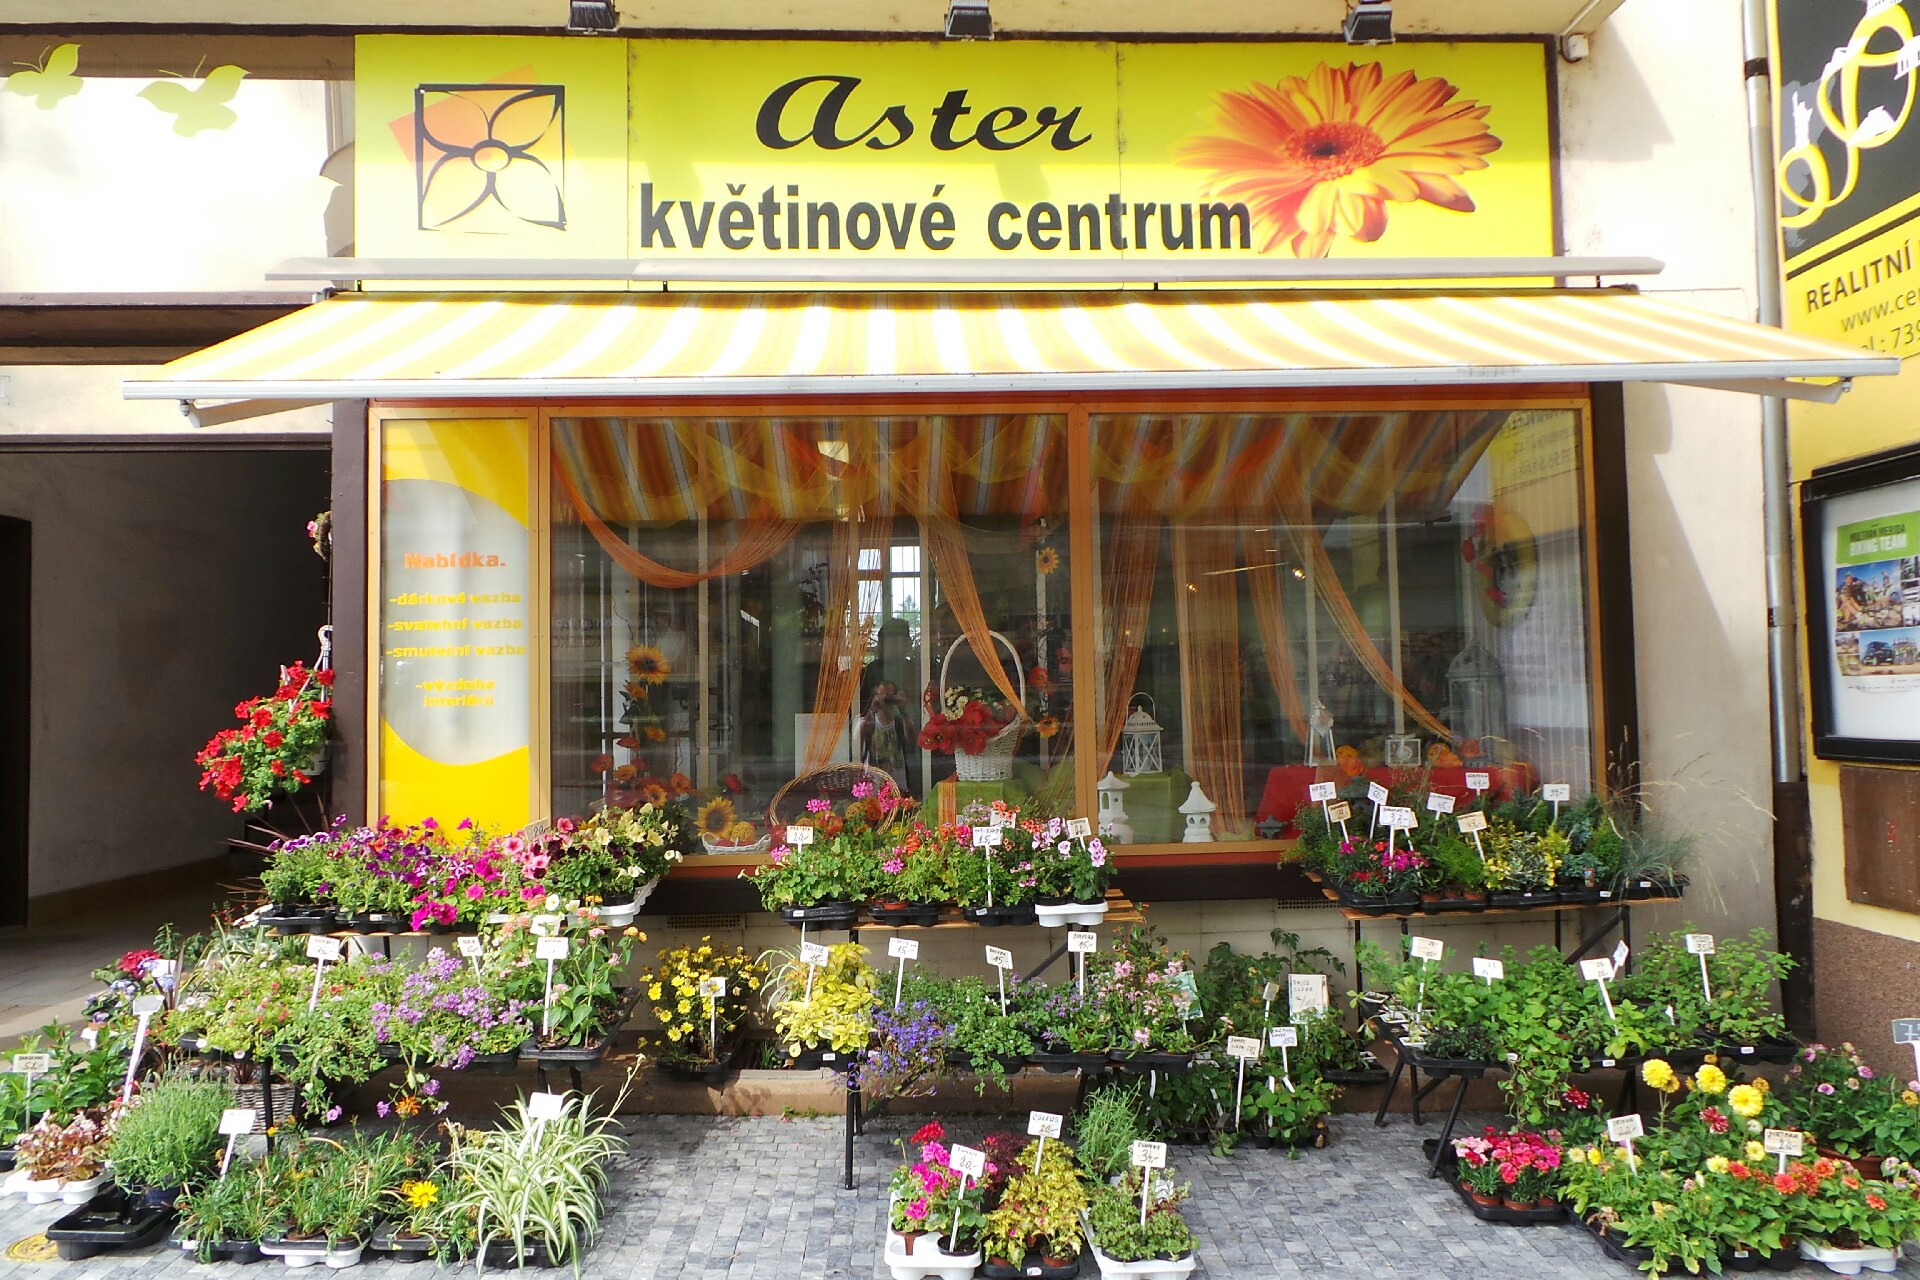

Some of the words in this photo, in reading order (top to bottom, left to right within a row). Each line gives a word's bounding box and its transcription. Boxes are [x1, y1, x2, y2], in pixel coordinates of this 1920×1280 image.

[640, 182, 956, 251] květinové
[987, 193, 1253, 252] centrum
[1806, 239, 1912, 313] REALITNÍ
[404, 552, 506, 569] Nabídka.
